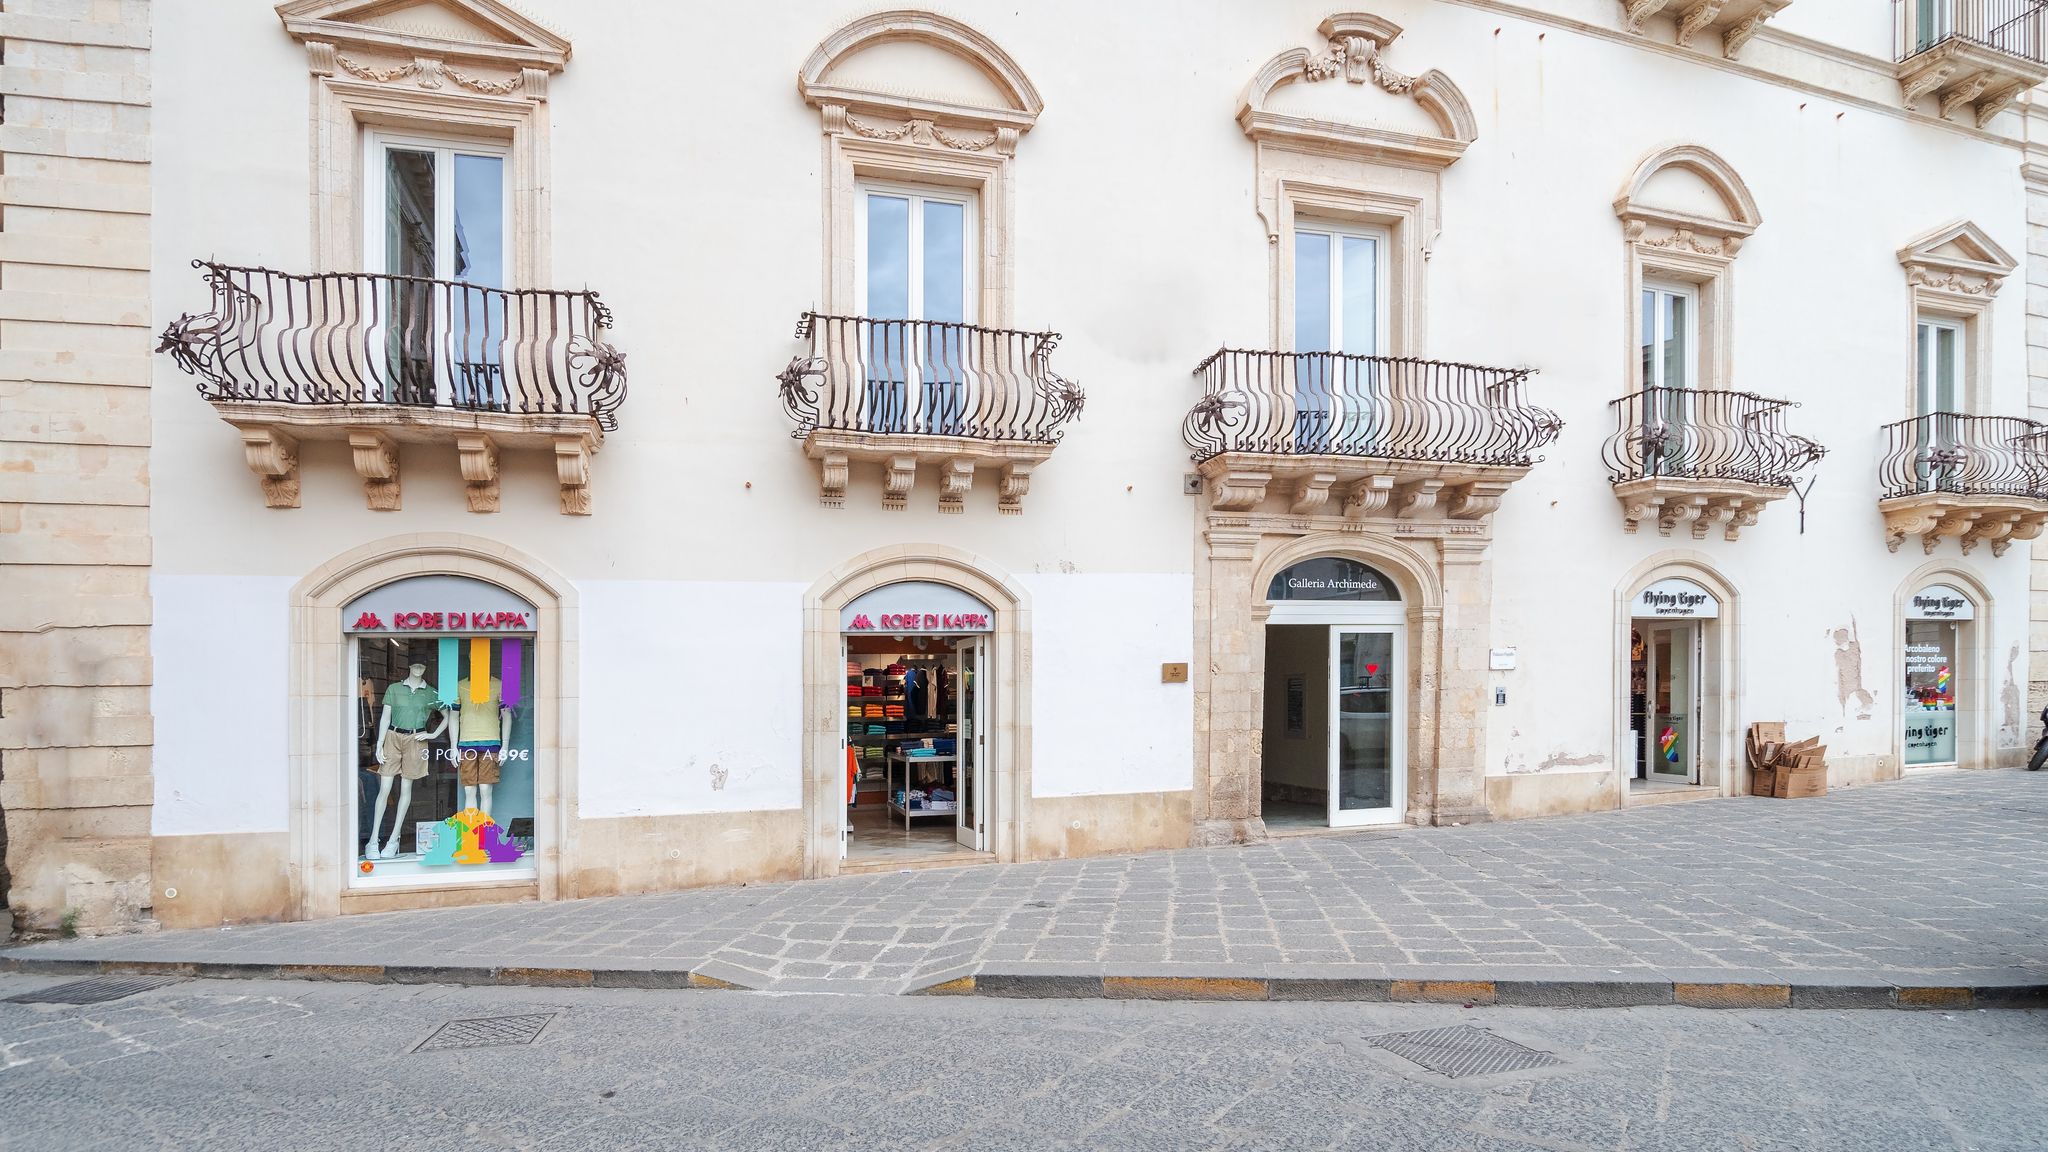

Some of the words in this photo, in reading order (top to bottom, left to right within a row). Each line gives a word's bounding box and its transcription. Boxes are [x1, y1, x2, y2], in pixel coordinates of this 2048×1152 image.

[1288, 578, 1325, 588] Galleria
[1327, 579, 1378, 589] Archimede
[1643, 591, 1676, 607] flying
[1678, 592, 1707, 607] tiger
[1913, 596, 1940, 610] flying
[1941, 596, 1965, 610] tiger
[1656, 608, 1694, 616] copenhagen
[393, 612, 443, 631] ROBE
[448, 612, 466, 630] DI
[471, 612, 527, 630] KAPPA
[881, 614, 920, 630] ROBE
[924, 614, 939, 630] DI
[943, 614, 987, 629] KAPPA
[1904, 644, 1940, 653] Arcobaleno
[1905, 655, 1926, 663] nostro
[1928, 654, 1947, 663] colore
[1907, 664, 1936, 675] preferito
[1905, 726, 1923, 740] ying
[1924, 725, 1948, 738] tiger
[421, 749, 430, 761] 3
[436, 749, 478, 761] POLO
[482, 749, 494, 760] A
